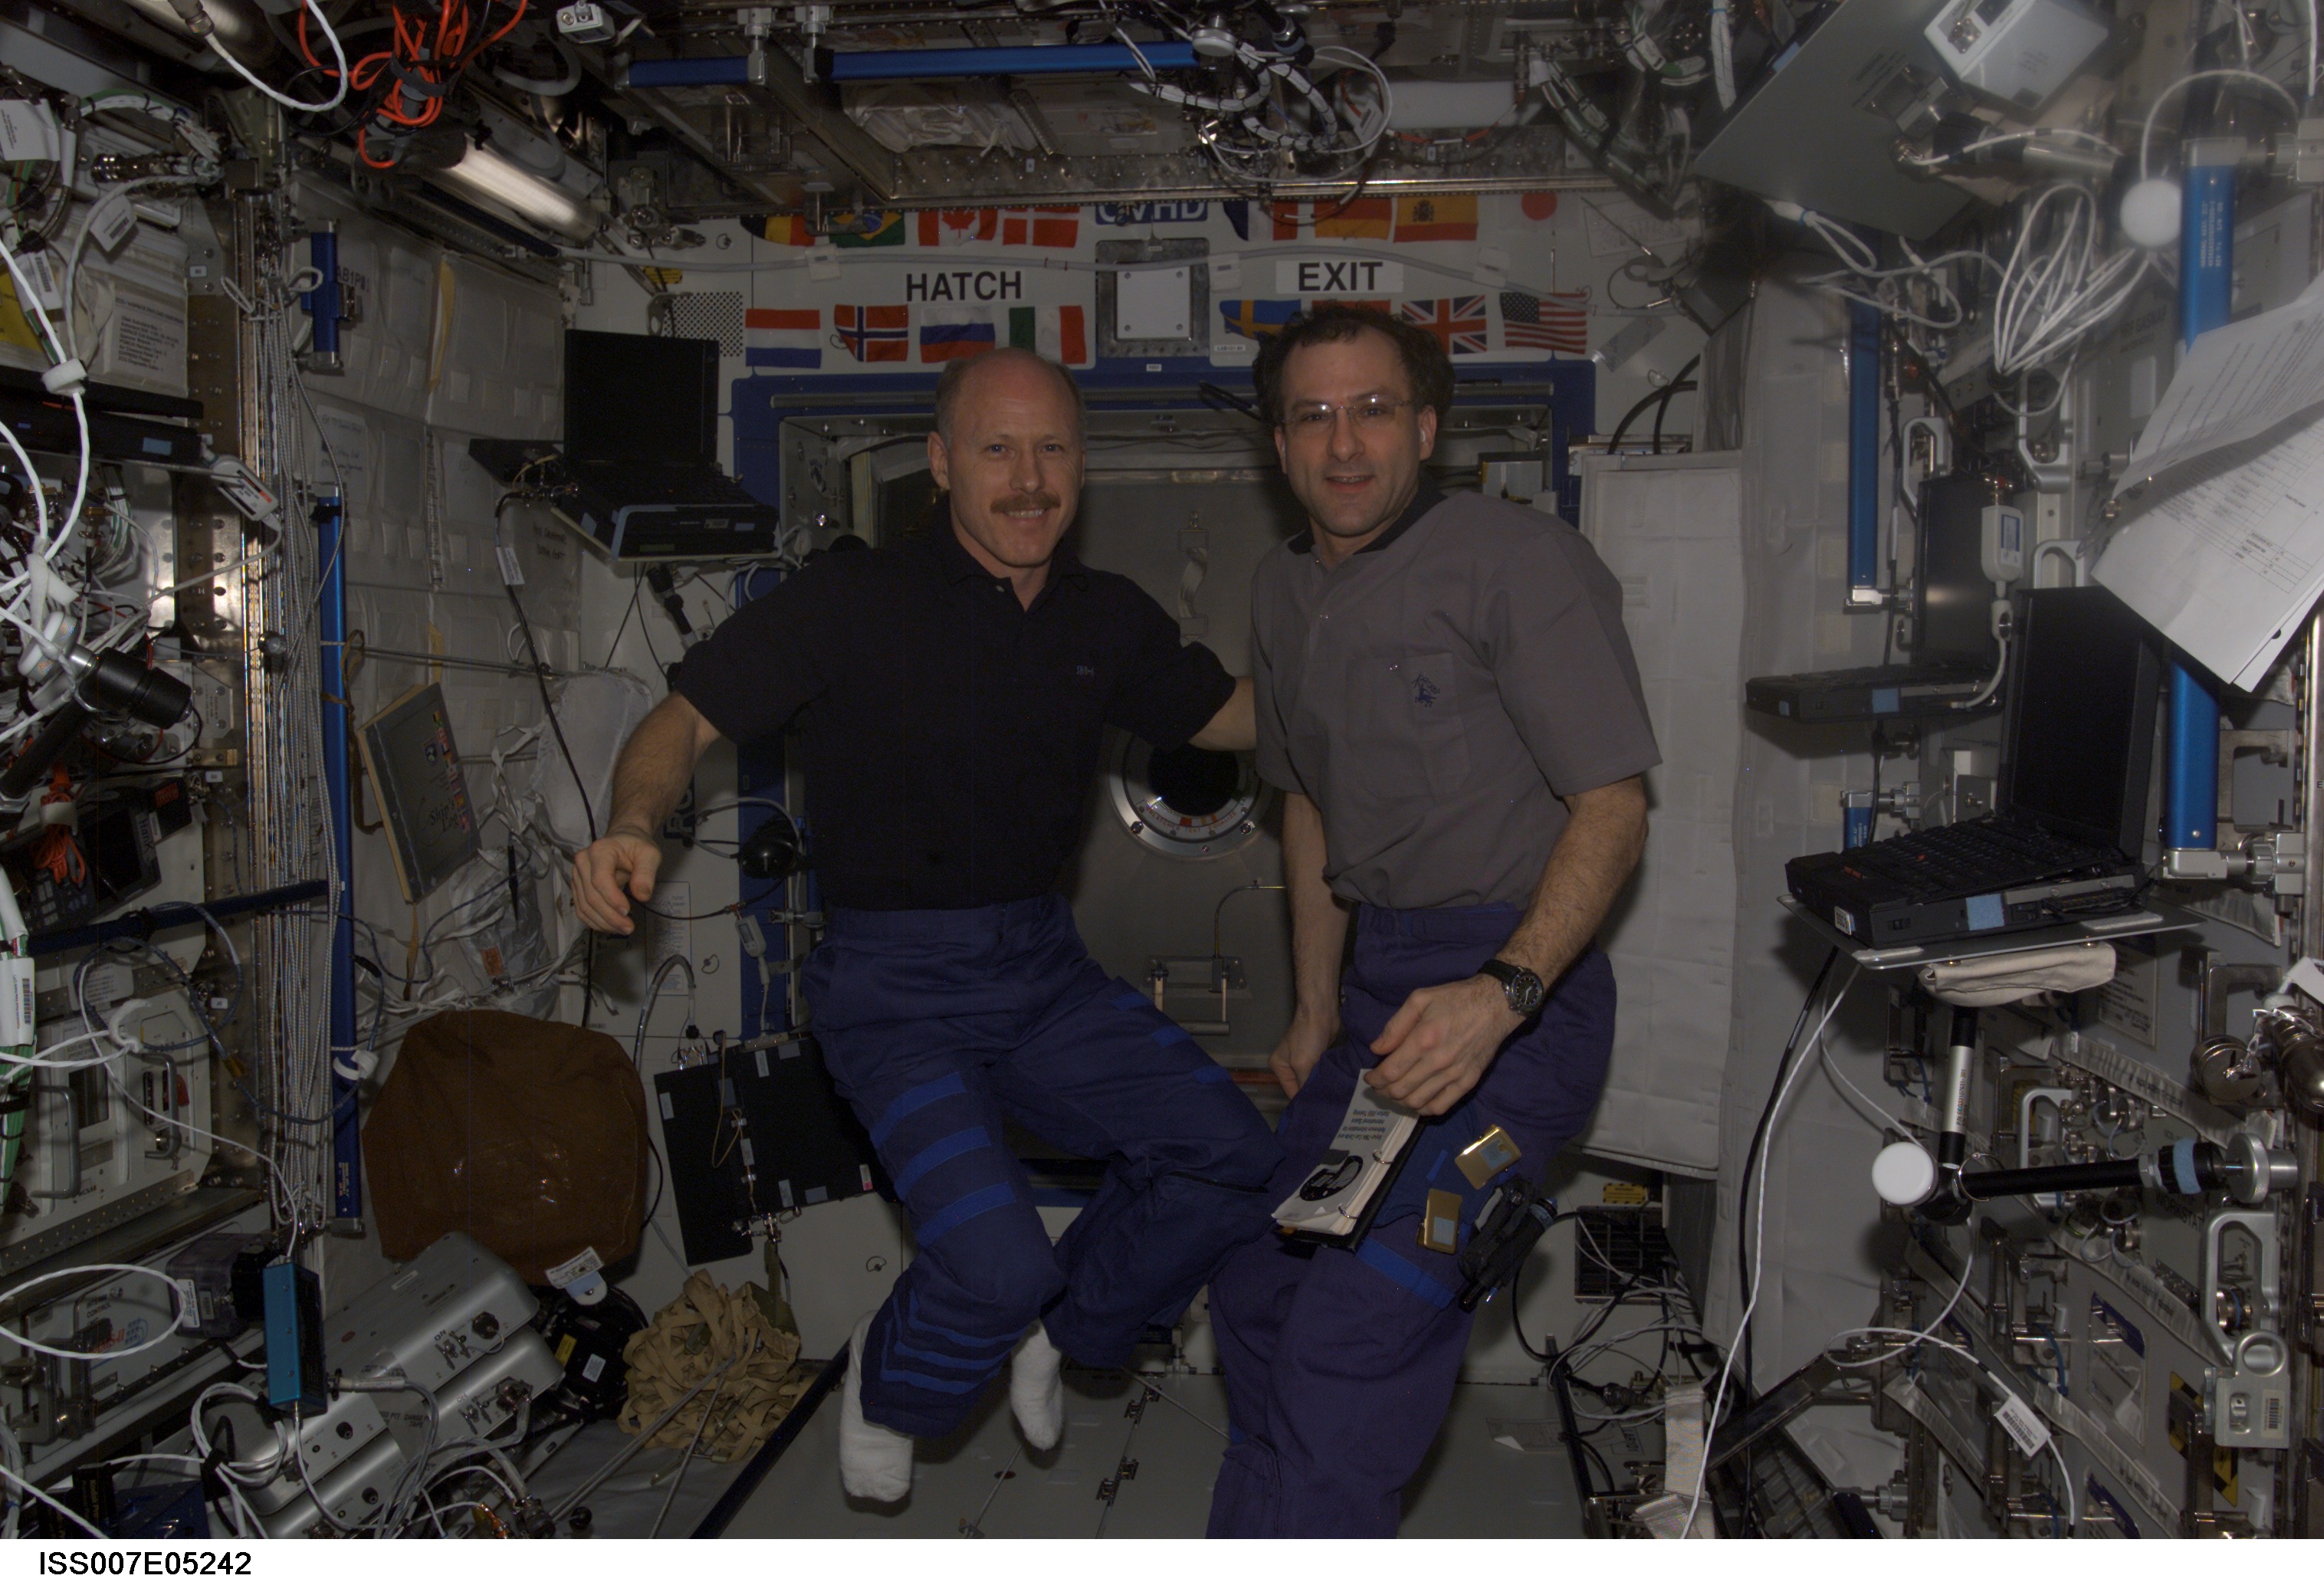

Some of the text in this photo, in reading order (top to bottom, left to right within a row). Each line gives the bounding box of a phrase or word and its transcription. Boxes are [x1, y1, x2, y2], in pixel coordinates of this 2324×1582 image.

[907, 271, 1021, 302] HATCH
[1299, 262, 1382, 292] EXIT
[429, 798, 455, 826] Ship's
[435, 1329, 446, 1341] ON
